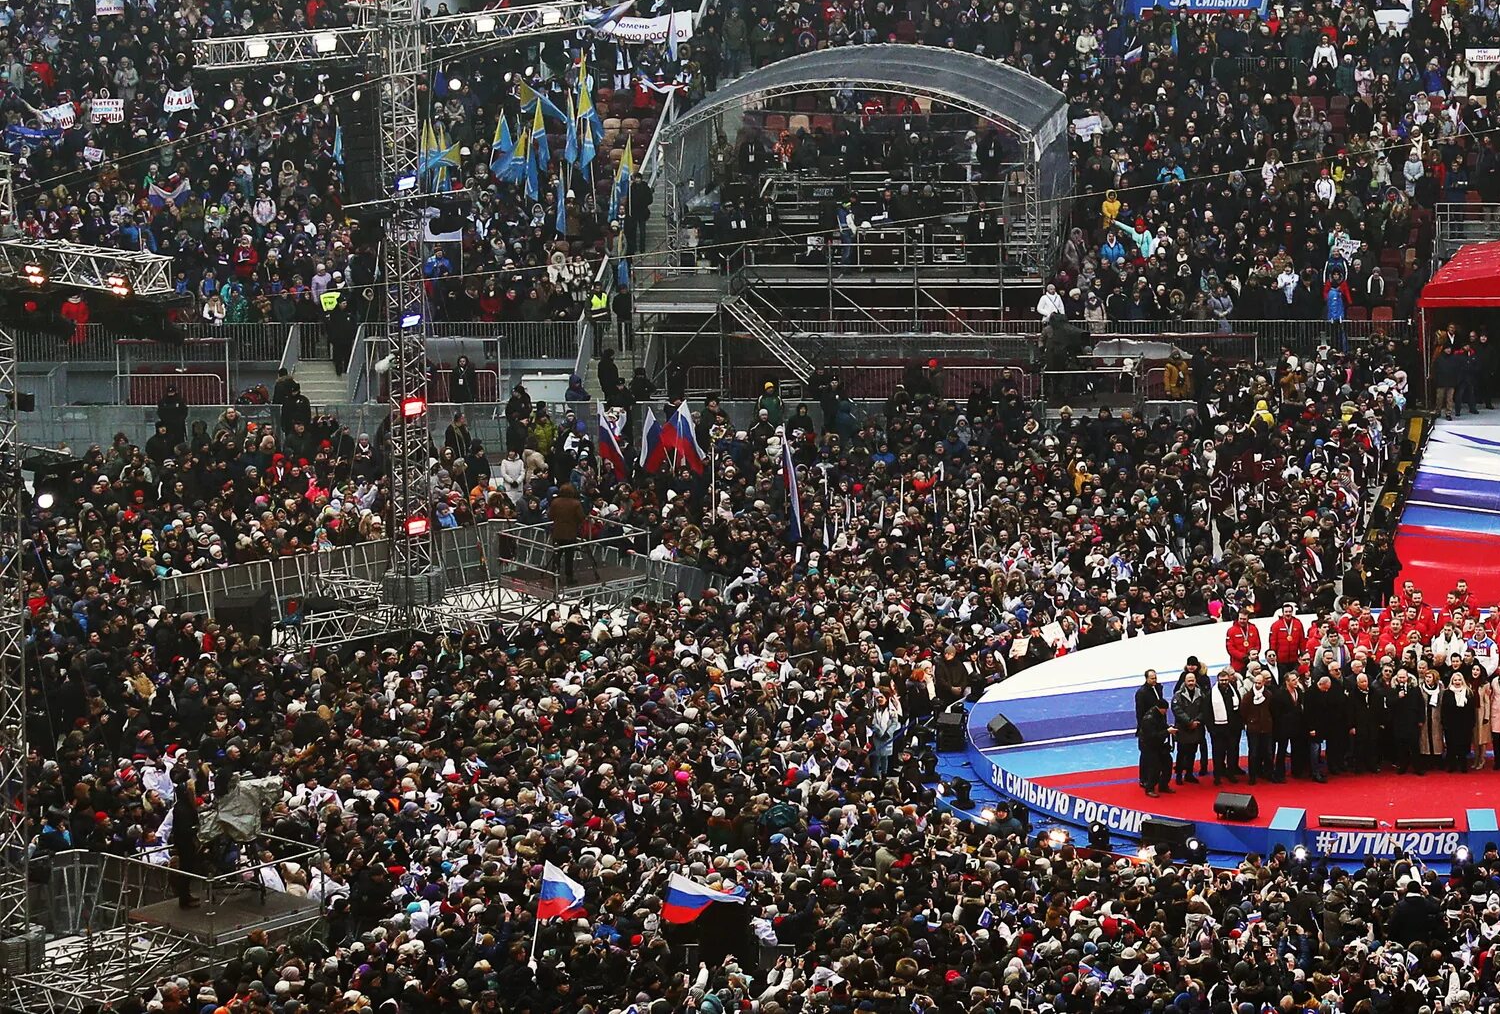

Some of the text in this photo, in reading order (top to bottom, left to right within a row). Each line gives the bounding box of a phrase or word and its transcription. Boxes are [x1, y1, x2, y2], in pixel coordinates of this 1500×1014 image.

[166, 94, 193, 106] НАШ
[991, 763, 1004, 789] ЗА
[1006, 774, 1070, 815] СИЛЬНУЮ
[1316, 831, 1460, 855] #ПУТИН2018
